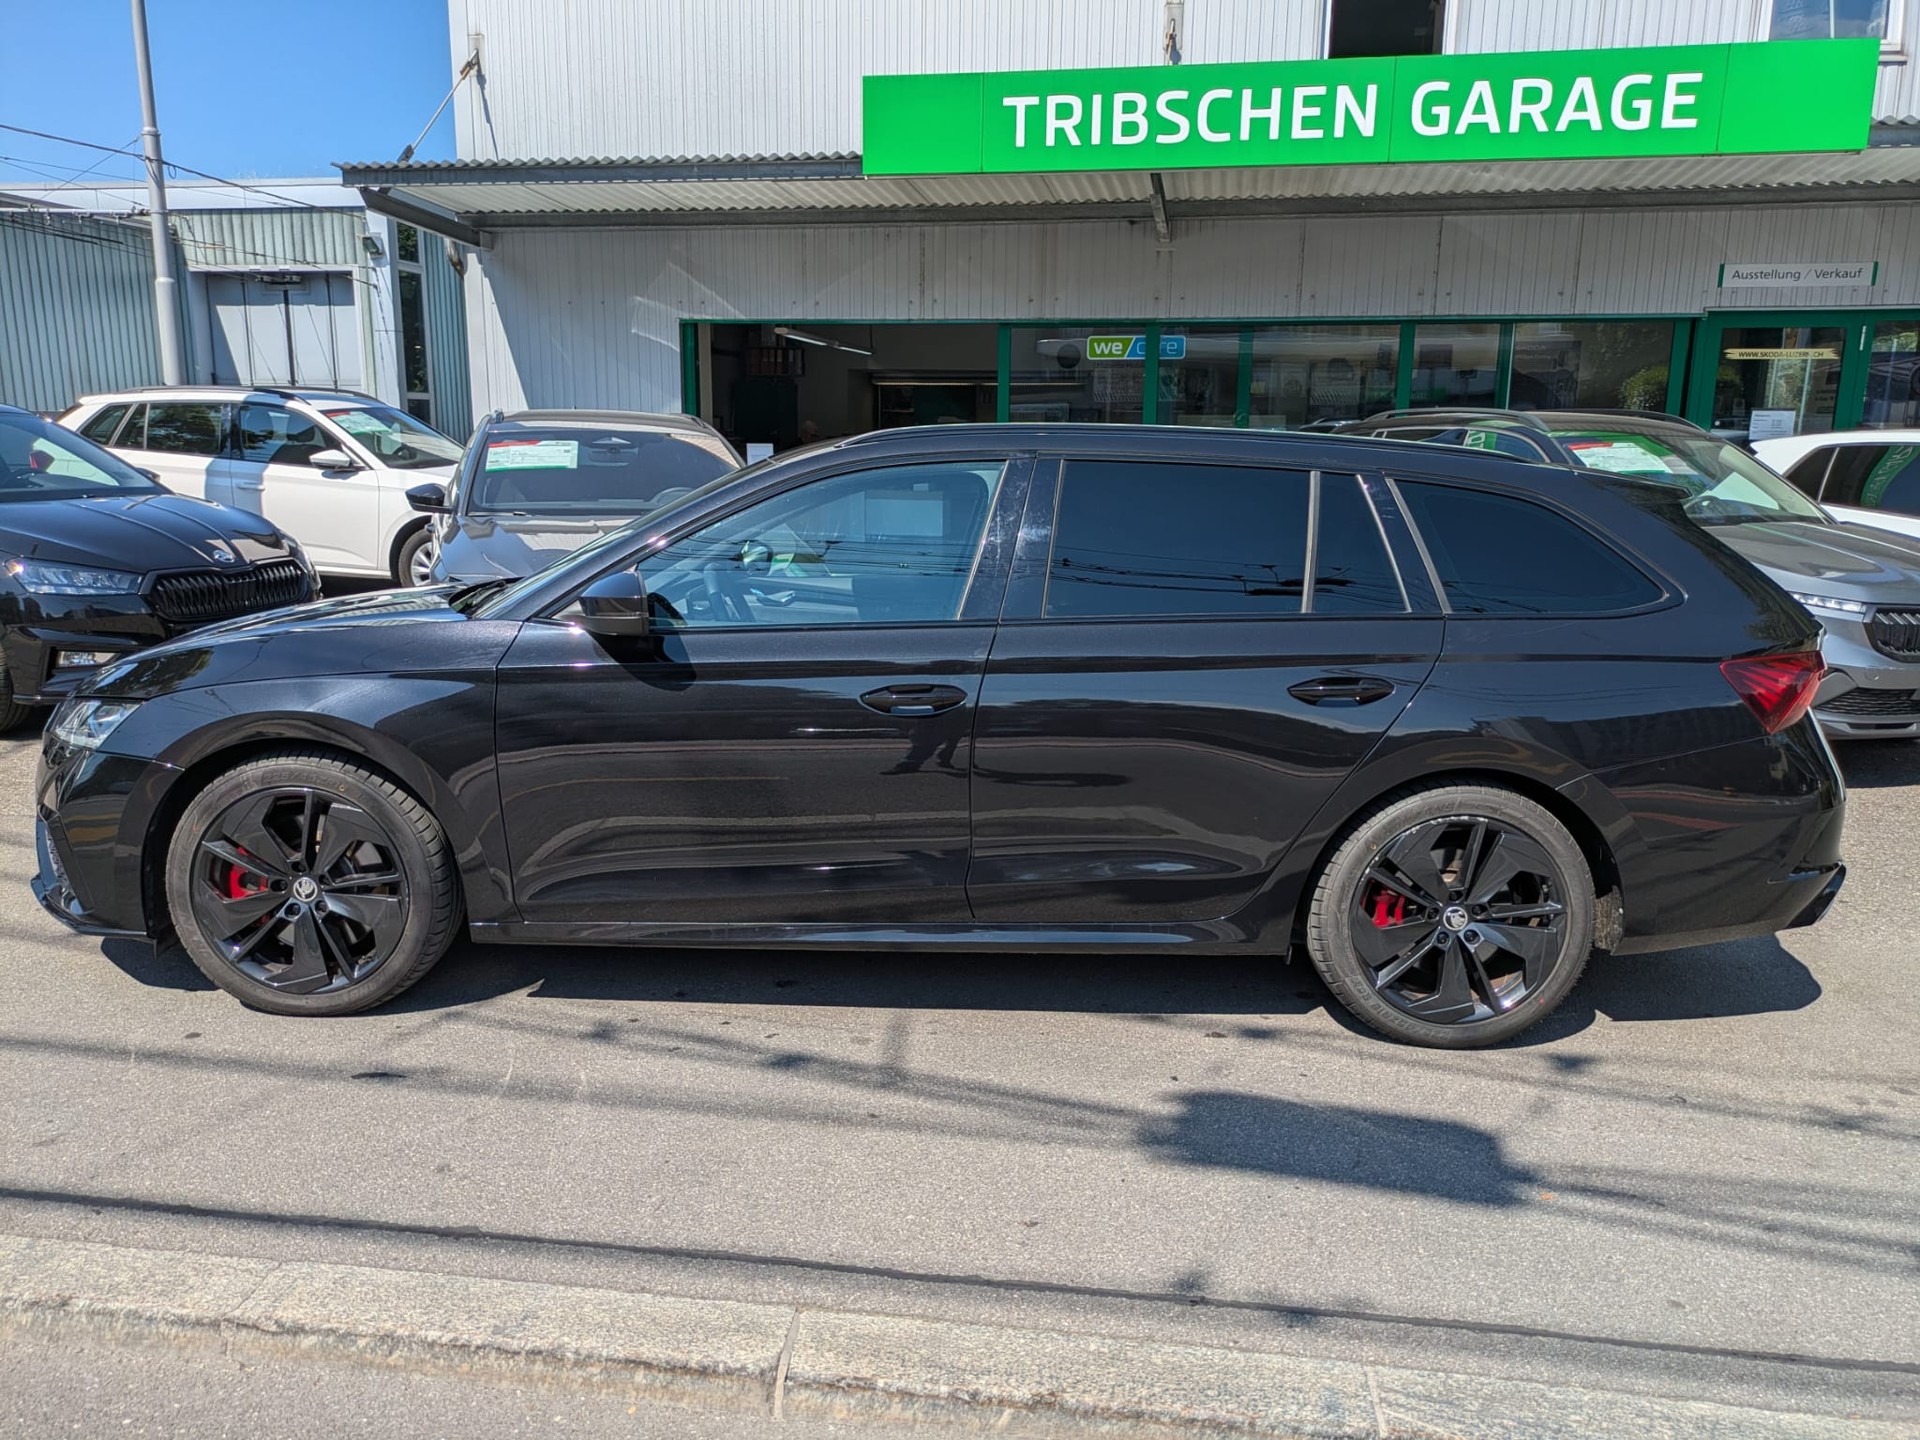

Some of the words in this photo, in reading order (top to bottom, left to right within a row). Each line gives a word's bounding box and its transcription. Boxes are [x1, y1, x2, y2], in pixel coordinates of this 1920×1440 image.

[1002, 84, 1378, 147] TRIBSCHEN
[1411, 73, 1703, 136] GARAGE
[1731, 269, 1801, 282] Ausstellung
[1814, 267, 1864, 279] Verkauf
[1093, 341, 1123, 355] we
[1136, 341, 1178, 355] cre
